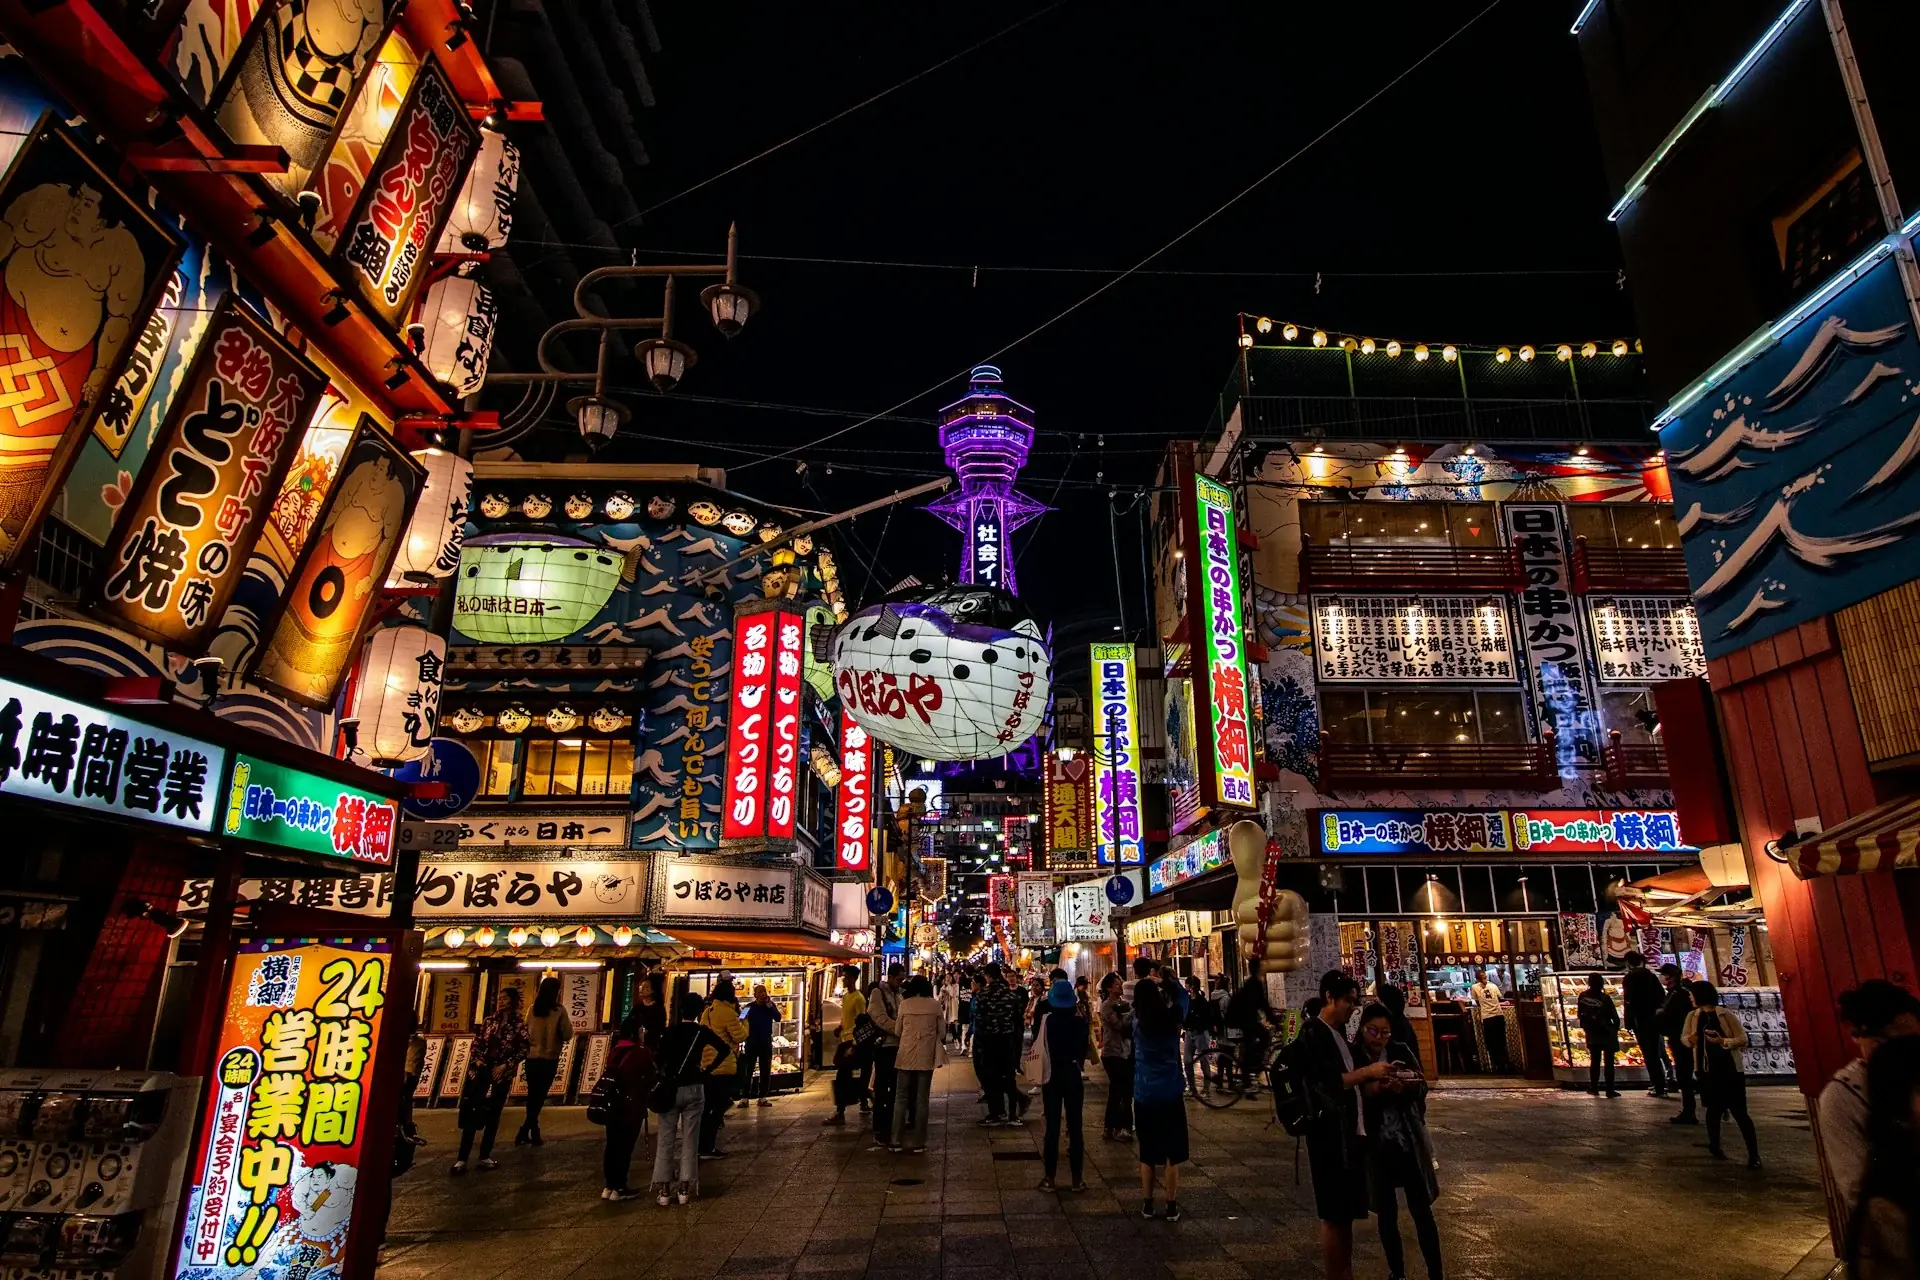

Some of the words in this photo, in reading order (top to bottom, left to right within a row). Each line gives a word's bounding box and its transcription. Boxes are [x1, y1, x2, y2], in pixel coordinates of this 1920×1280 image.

[214, 327, 273, 402] 名物
[179, 375, 303, 628] 大阪下町の味
[977, 525, 997, 586] 社会イ
[1206, 506, 1237, 661] 日本一の串かつ
[1512, 510, 1577, 661] 日本一の串かつ
[457, 598, 562, 616] 私の味は日本一
[743, 624, 767, 677] 名物
[779, 624, 801, 677] 名物
[1321, 636, 1335, 677] もち
[1334, 636, 1350, 677] うずら玉子
[1360, 636, 1376, 677] にんにく
[1374, 636, 1389, 677] 玉ねぎ
[1387, 636, 1403, 677] 山芋
[1401, 636, 1416, 677] しし唐
[1414, 636, 1430, 677] れんこん
[1427, 636, 1443, 677] 銀杏
[1441, 636, 1456, 677] 白ねぎ
[1454, 636, 1470, 677] さつま芋
[1480, 636, 1497, 677] 茄子
[1494, 636, 1510, 677] 椎茸
[1598, 637, 1617, 677] 海老
[1612, 637, 1630, 677] キス
[1625, 637, 1643, 677] 貝柱
[1638, 637, 1656, 677] サーモン
[1651, 637, 1669, 677] たこ
[1664, 637, 1682, 677] いか
[1690, 637, 1708, 677] ホルモン
[1102, 662, 1130, 766] 日本一の串かつ
[1211, 661, 1250, 774] 横綱
[733, 713, 763, 826] てっちり
[771, 714, 797, 826] てっちり
[842, 712, 868, 864] 珍味てっちり
[1099, 769, 1140, 844] 横綱
[1222, 777, 1252, 804] 酒処
[244, 784, 332, 833] 日本一の串かつ
[330, 793, 395, 862] 横綱
[1053, 783, 1077, 848] 通天閣
[1078, 782, 1086, 848] TSUTENKAKU
[1339, 822, 1424, 843] 日本一の串かつ
[1424, 813, 1486, 850] 横綱
[1486, 815, 1506, 849] 酒処
[1529, 820, 1612, 843] 日本一の串かつ
[1612, 812, 1676, 850] 横綱
[181, 878, 398, 908] ふ料理専門
[673, 879, 786, 904] づぼらや本店
[257, 955, 290, 1005] 横綱
[225, 1053, 254, 1069] 24
[303, 958, 384, 1147] 24時間
[223, 1068, 252, 1083] 時間
